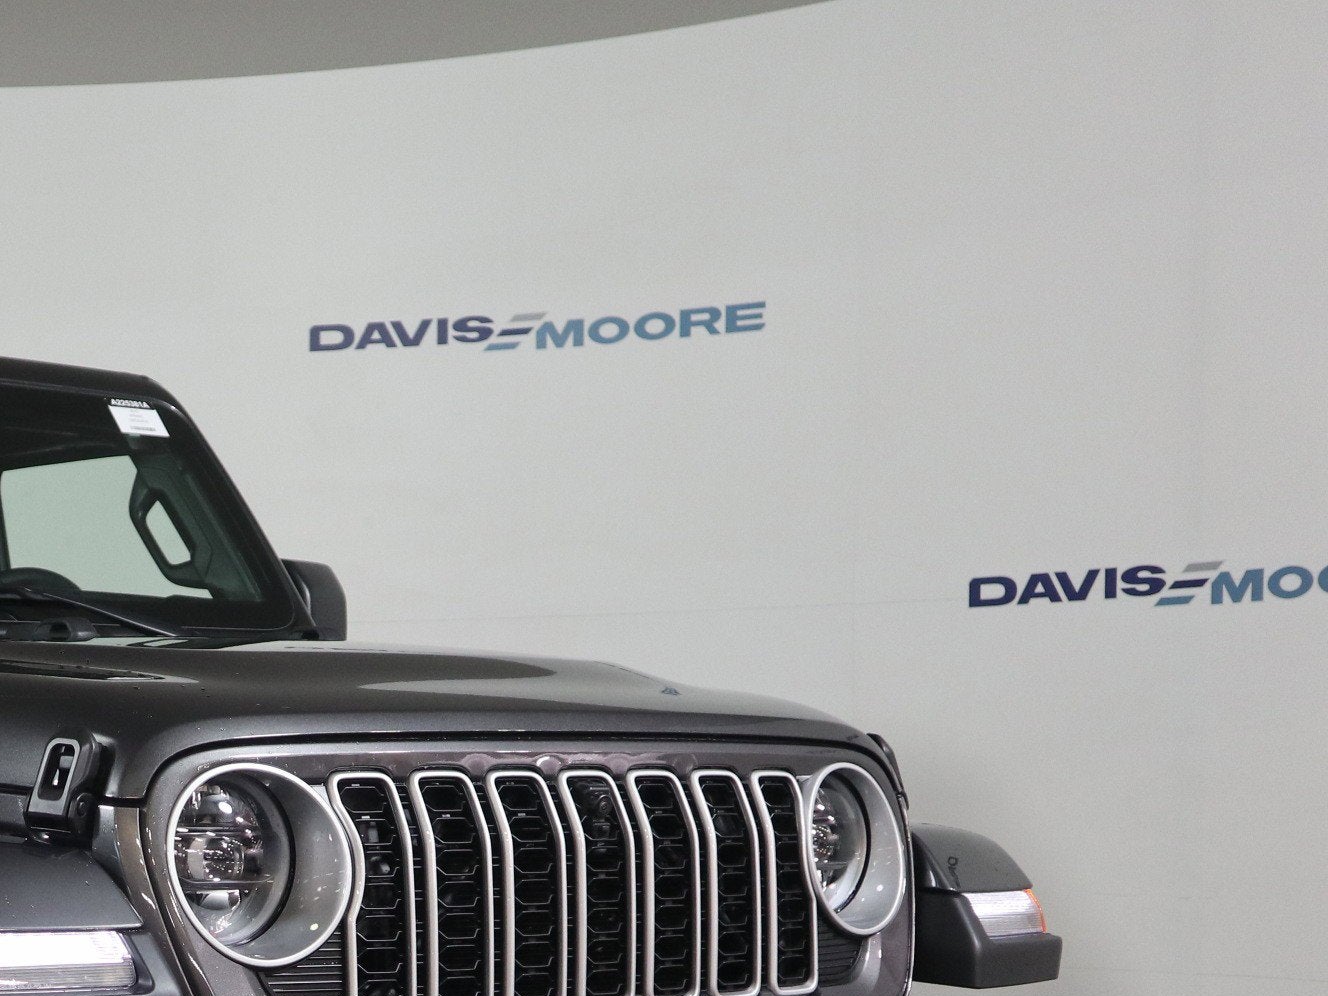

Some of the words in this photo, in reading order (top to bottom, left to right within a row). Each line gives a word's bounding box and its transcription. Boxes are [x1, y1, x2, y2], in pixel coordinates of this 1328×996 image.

[308, 314, 494, 352] DAVIS
[535, 300, 767, 350] MOORE
[968, 564, 1167, 608] DAVIS
[1210, 564, 1328, 605] MO
